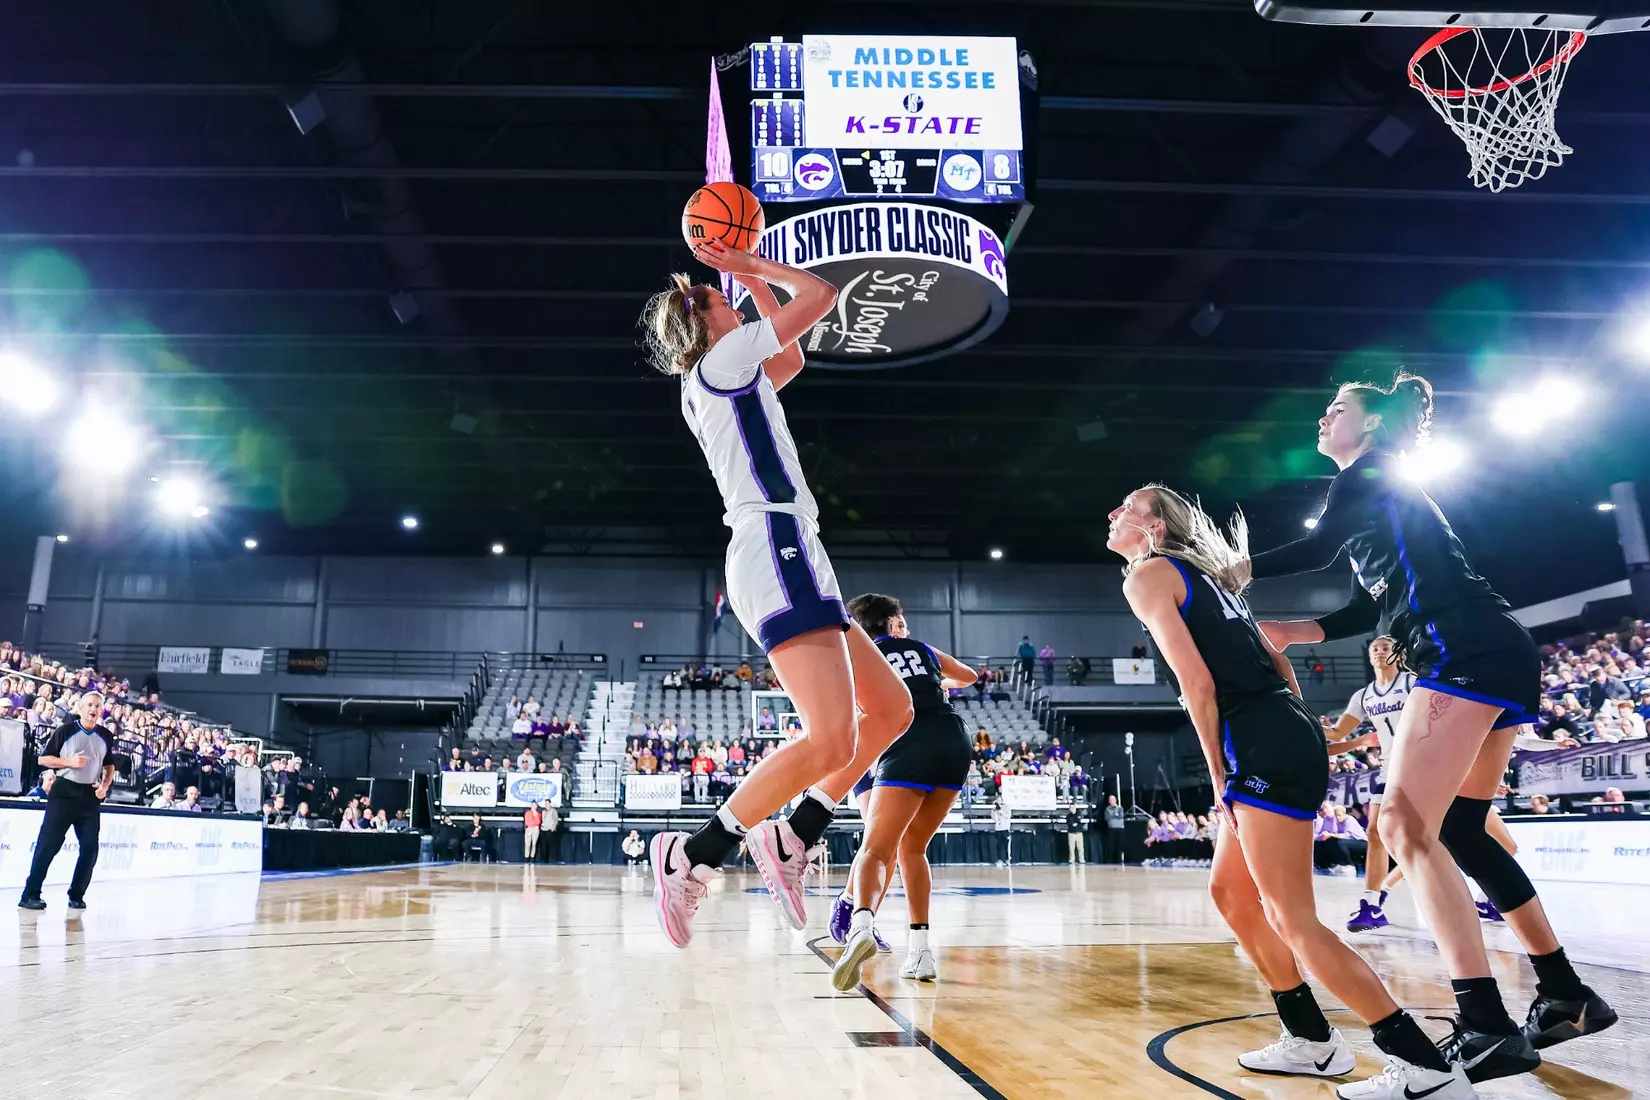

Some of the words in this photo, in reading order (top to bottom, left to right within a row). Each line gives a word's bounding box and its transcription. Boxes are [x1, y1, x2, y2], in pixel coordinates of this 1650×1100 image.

[853, 48, 969, 67] MIDDLE
[828, 70, 996, 90] TENNESSEE
[845, 116, 983, 135] K-STATE
[760, 152, 788, 178] 10
[869, 160, 905, 178] 3:07
[993, 154, 1010, 180] 8
[794, 207, 884, 265] SNYDER
[886, 206, 972, 264] CLASSIC
[866, 269, 916, 298] St.
[914, 270, 940, 290] City
[912, 291, 929, 303] of
[845, 296, 905, 354] Joseph
[160, 652, 207, 665] Fairfield
[233, 660, 260, 668] EAGLE
[886, 650, 928, 679] 22
[1384, 717, 1395, 737] 1
[1581, 754, 1637, 781] BILL
[460, 782, 491, 796] Altec
